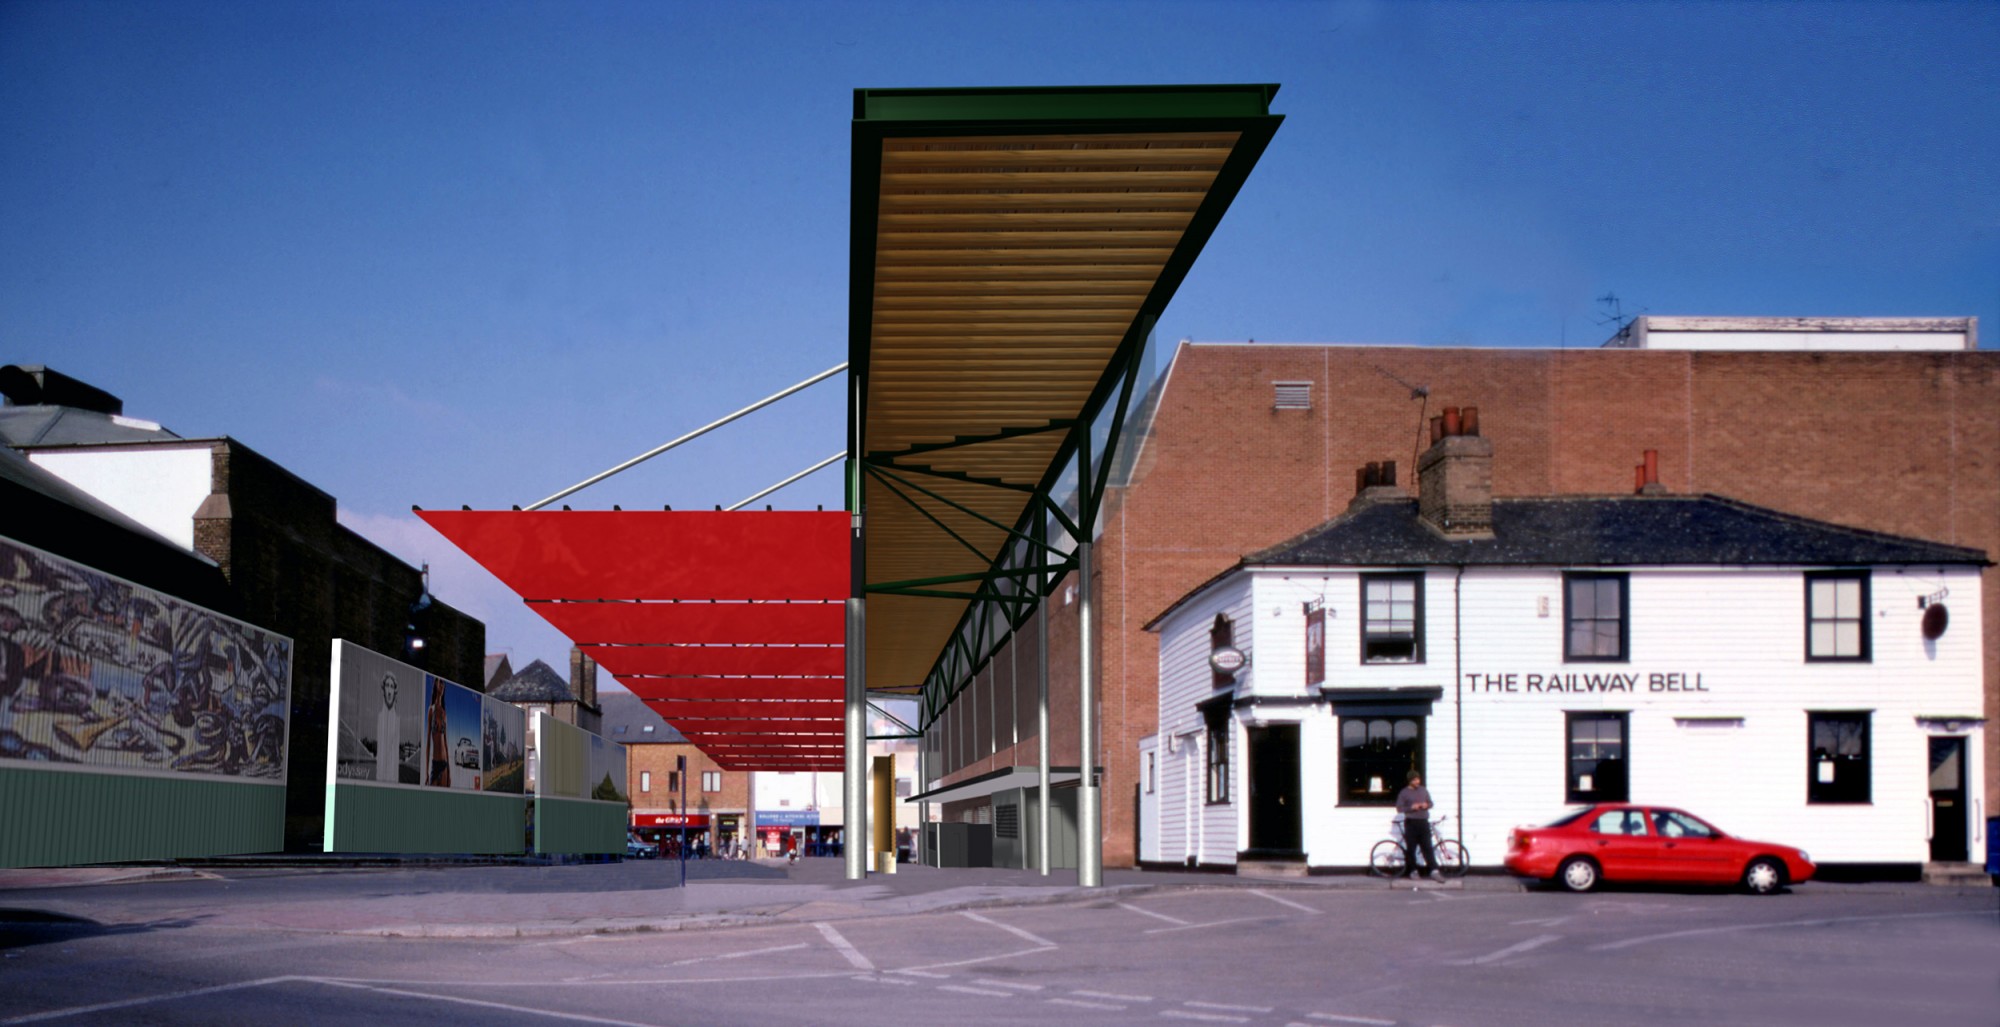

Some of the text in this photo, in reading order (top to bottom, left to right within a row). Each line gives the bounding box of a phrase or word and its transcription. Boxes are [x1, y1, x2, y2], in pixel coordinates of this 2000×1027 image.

[1465, 672, 1709, 692] THE RAILWAY BELL
